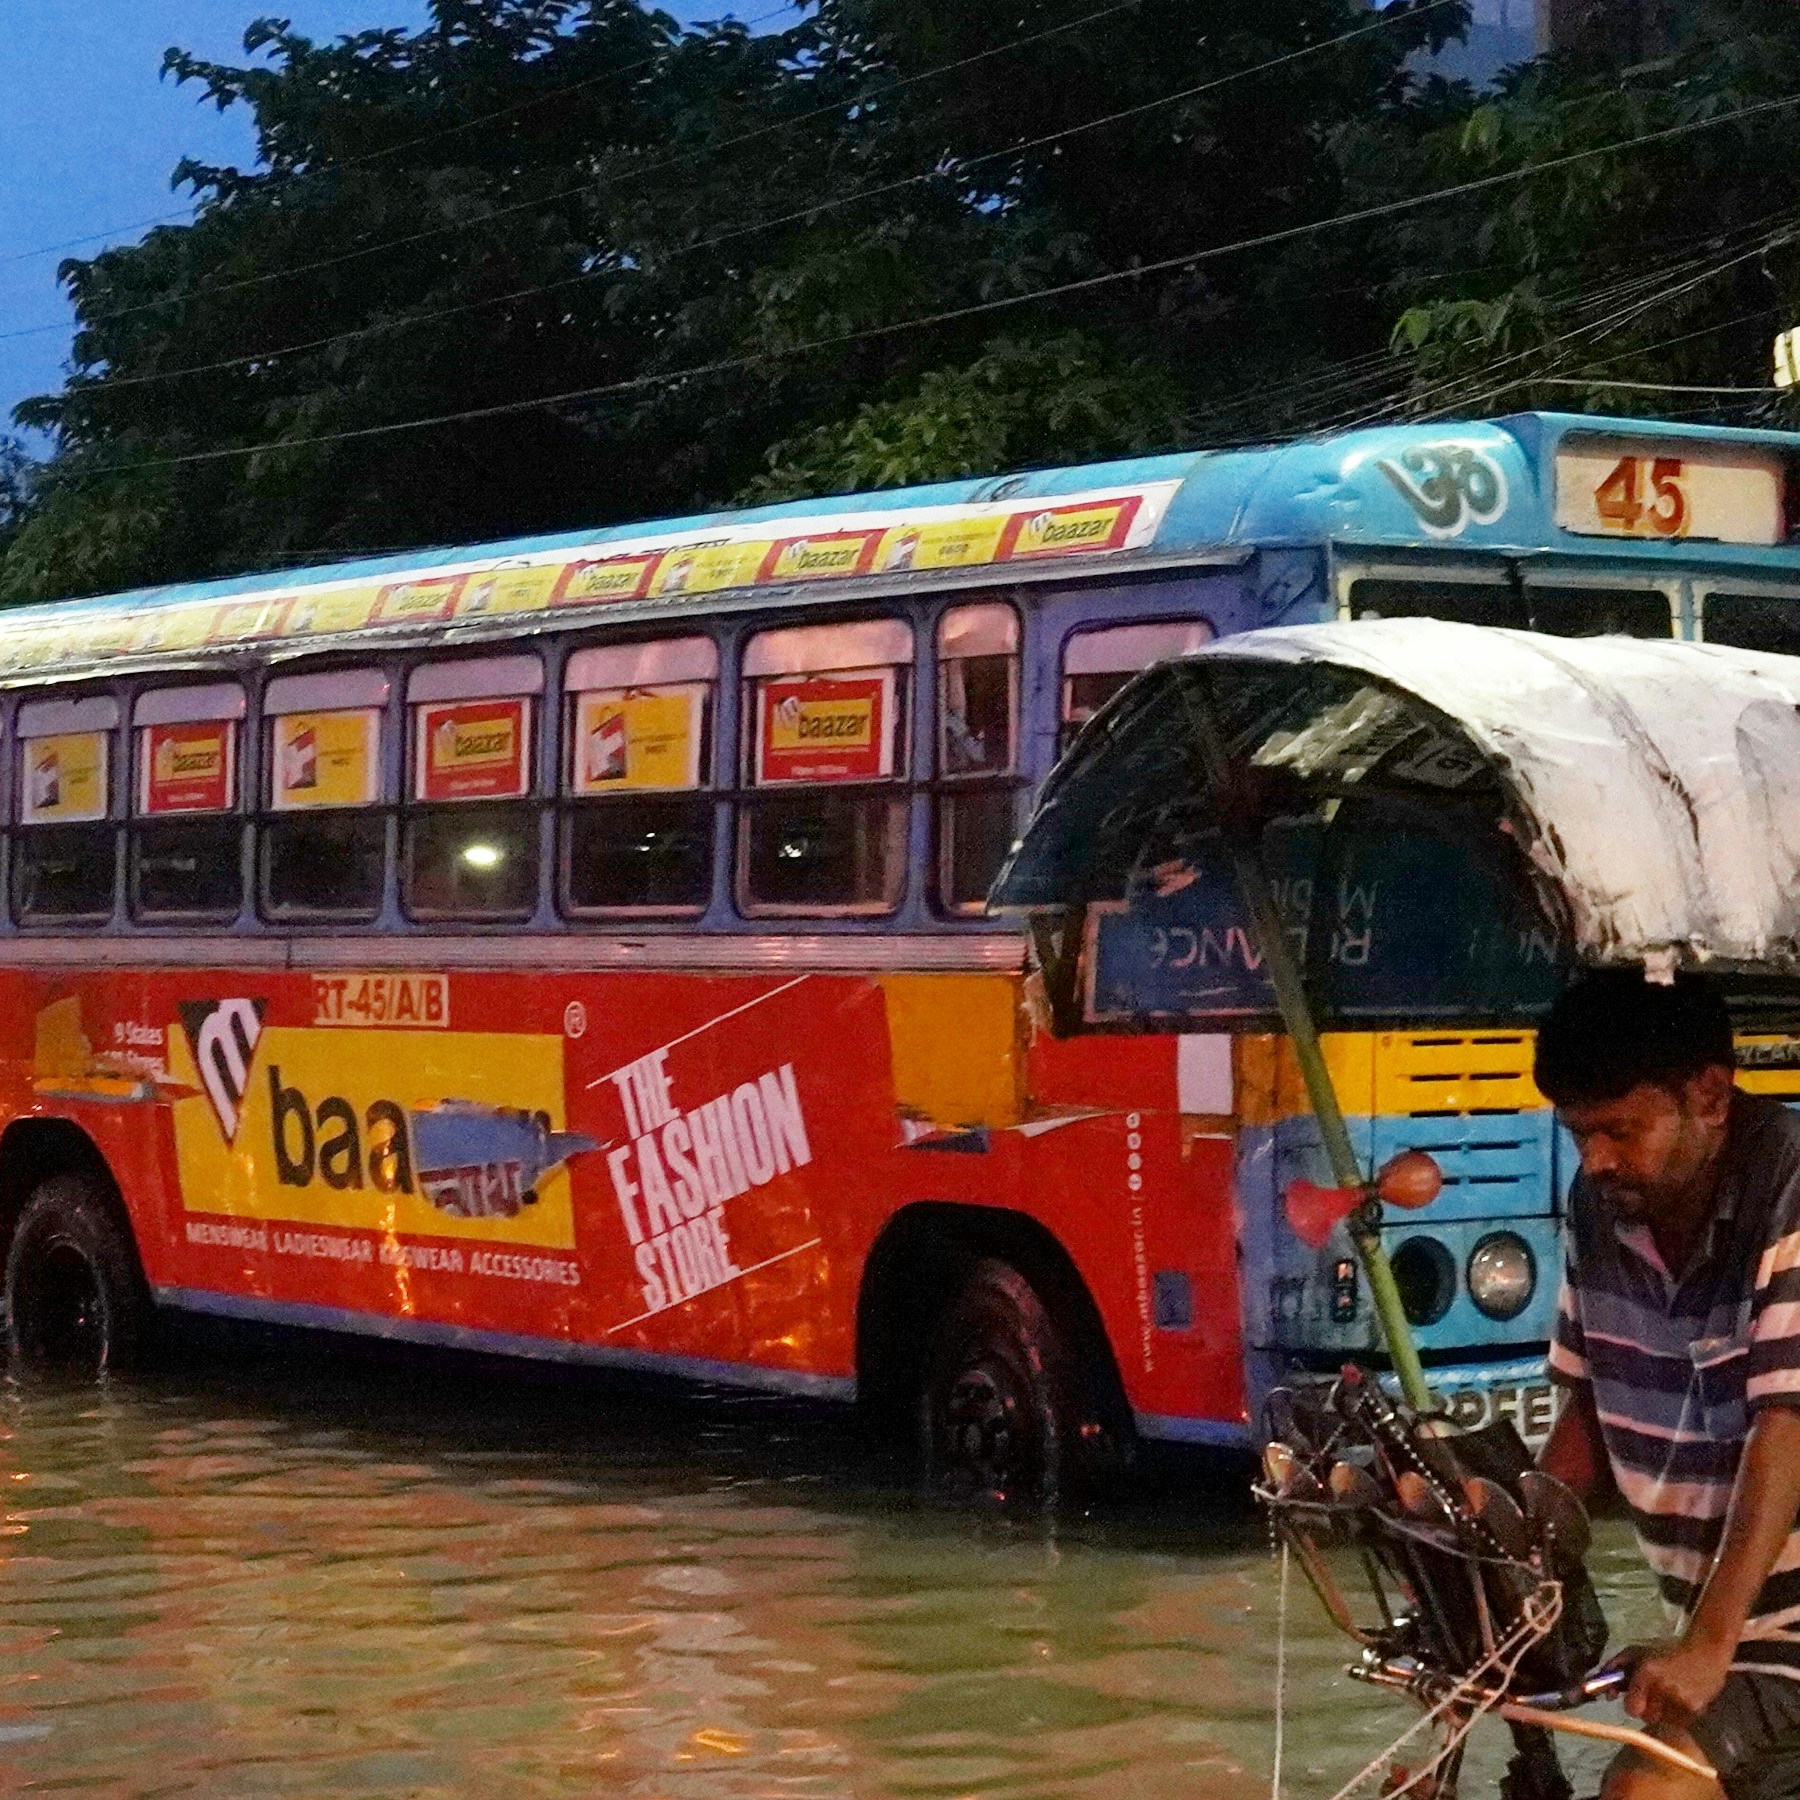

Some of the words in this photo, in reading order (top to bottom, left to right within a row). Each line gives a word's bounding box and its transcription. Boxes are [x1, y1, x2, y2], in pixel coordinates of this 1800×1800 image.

[1045, 514, 1112, 543] baazar
[1595, 455, 1694, 538] 45
[313, 977, 448, 1023] RT-45/A/B
[611, 1047, 680, 1140] THE
[607, 1062, 812, 1246] FASHION
[186, 1222, 269, 1254] MENSWEAR
[273, 1230, 372, 1266] LADIESWEAR
[470, 1252, 581, 1288] ACCESSORIES
[634, 1204, 741, 1310] STORE
